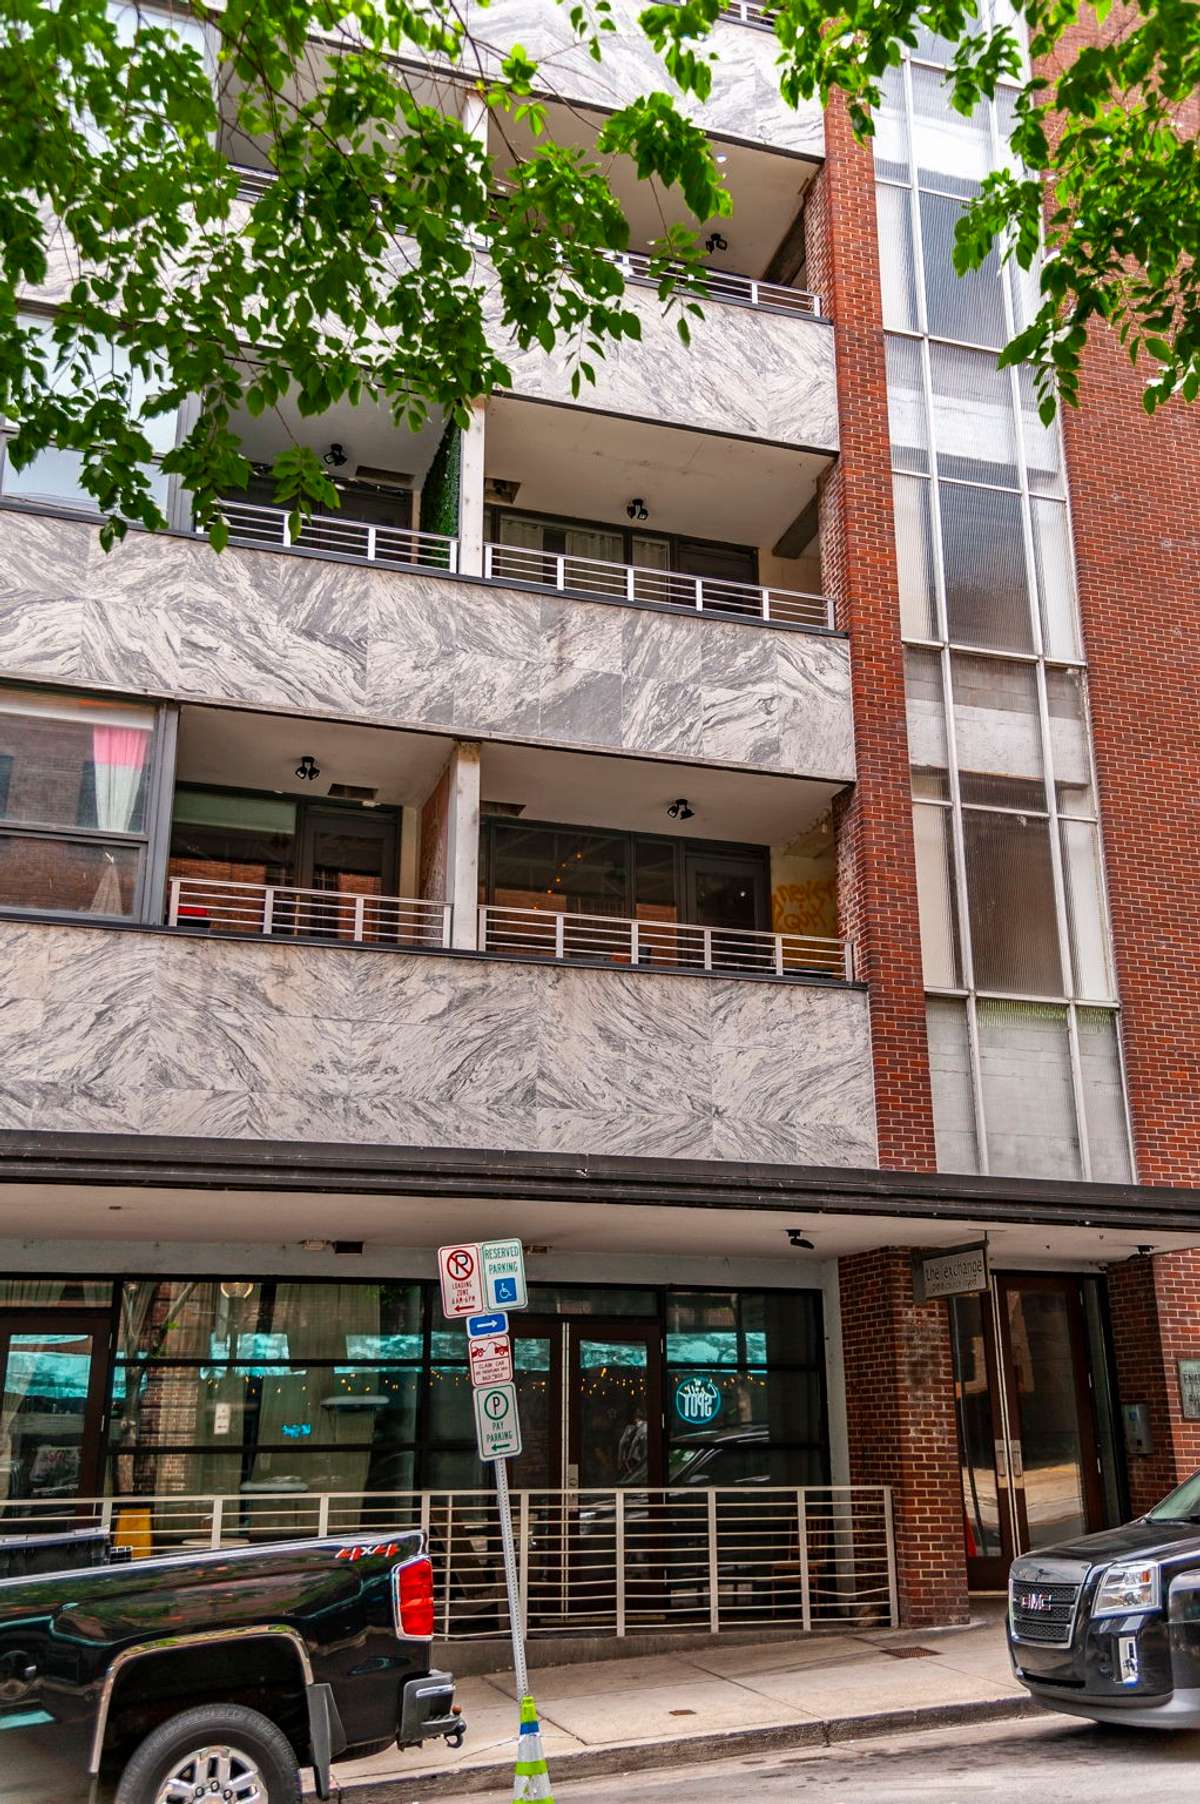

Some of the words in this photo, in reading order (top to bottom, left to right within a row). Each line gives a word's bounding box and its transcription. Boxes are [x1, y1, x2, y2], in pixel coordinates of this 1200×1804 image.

[484, 1246, 518, 1260] RESERVED
[488, 1261, 518, 1275] PARKING
[926, 1265, 940, 1281] the
[943, 1259, 983, 1279] exchange
[451, 1281, 473, 1290] LOADING
[456, 1289, 469, 1297] ZONE
[492, 1421, 504, 1431] PAY
[486, 1431, 513, 1443] PARKING
[1021, 1593, 1052, 1611] GMC
